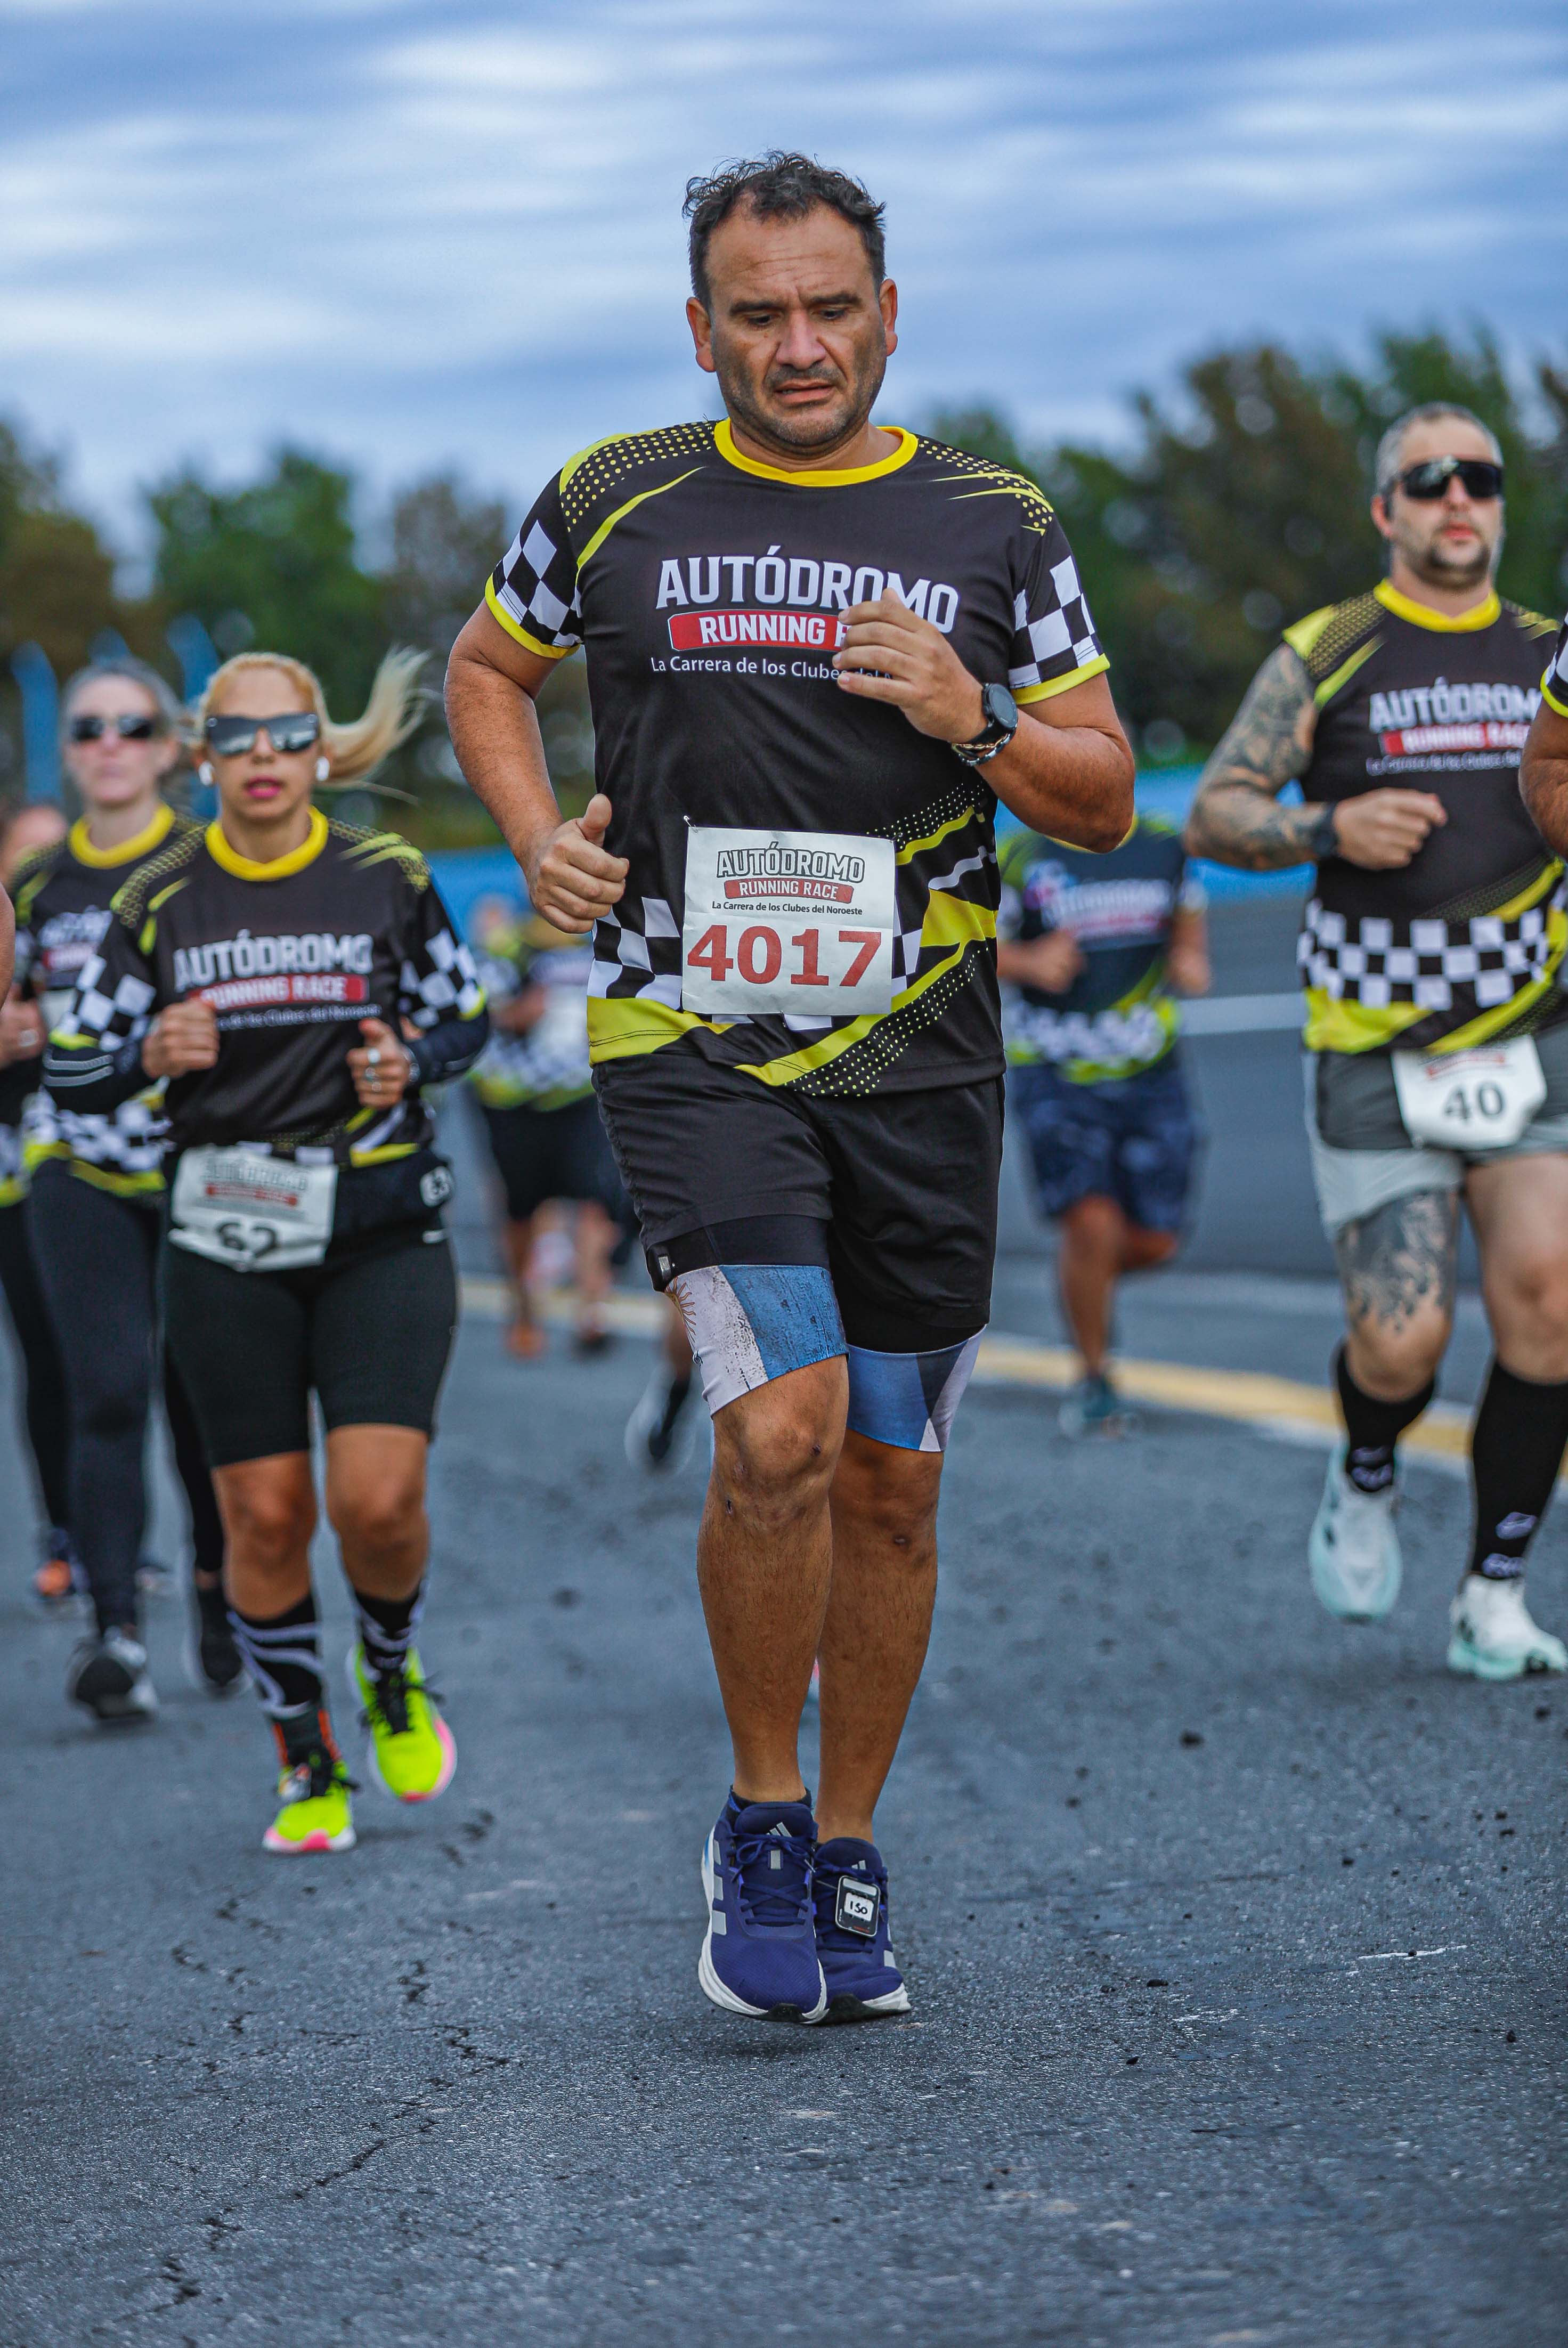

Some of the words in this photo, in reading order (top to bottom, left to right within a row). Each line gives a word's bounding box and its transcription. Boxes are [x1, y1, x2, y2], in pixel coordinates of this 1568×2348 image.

[655, 545, 958, 633] AUTÓDROMO
[698, 614, 827, 645] RUNNING
[651, 657, 666, 672] La
[670, 656, 731, 672] Carrera
[736, 657, 758, 673] de
[762, 659, 786, 676] los
[1369, 676, 1543, 734] AUTÓDROM
[716, 841, 865, 884] AUTÓDROMO
[712, 901, 721, 909] La
[724, 901, 754, 911] Carrera
[756, 902, 767, 912] de
[768, 903, 781, 912] los
[782, 903, 810, 913] Clubes
[811, 904, 824, 914] del
[826, 906, 863, 915] Noroeste
[738, 880, 799, 896] RUNNING
[803, 882, 839, 900] RACE
[687, 924, 882, 987] 4017
